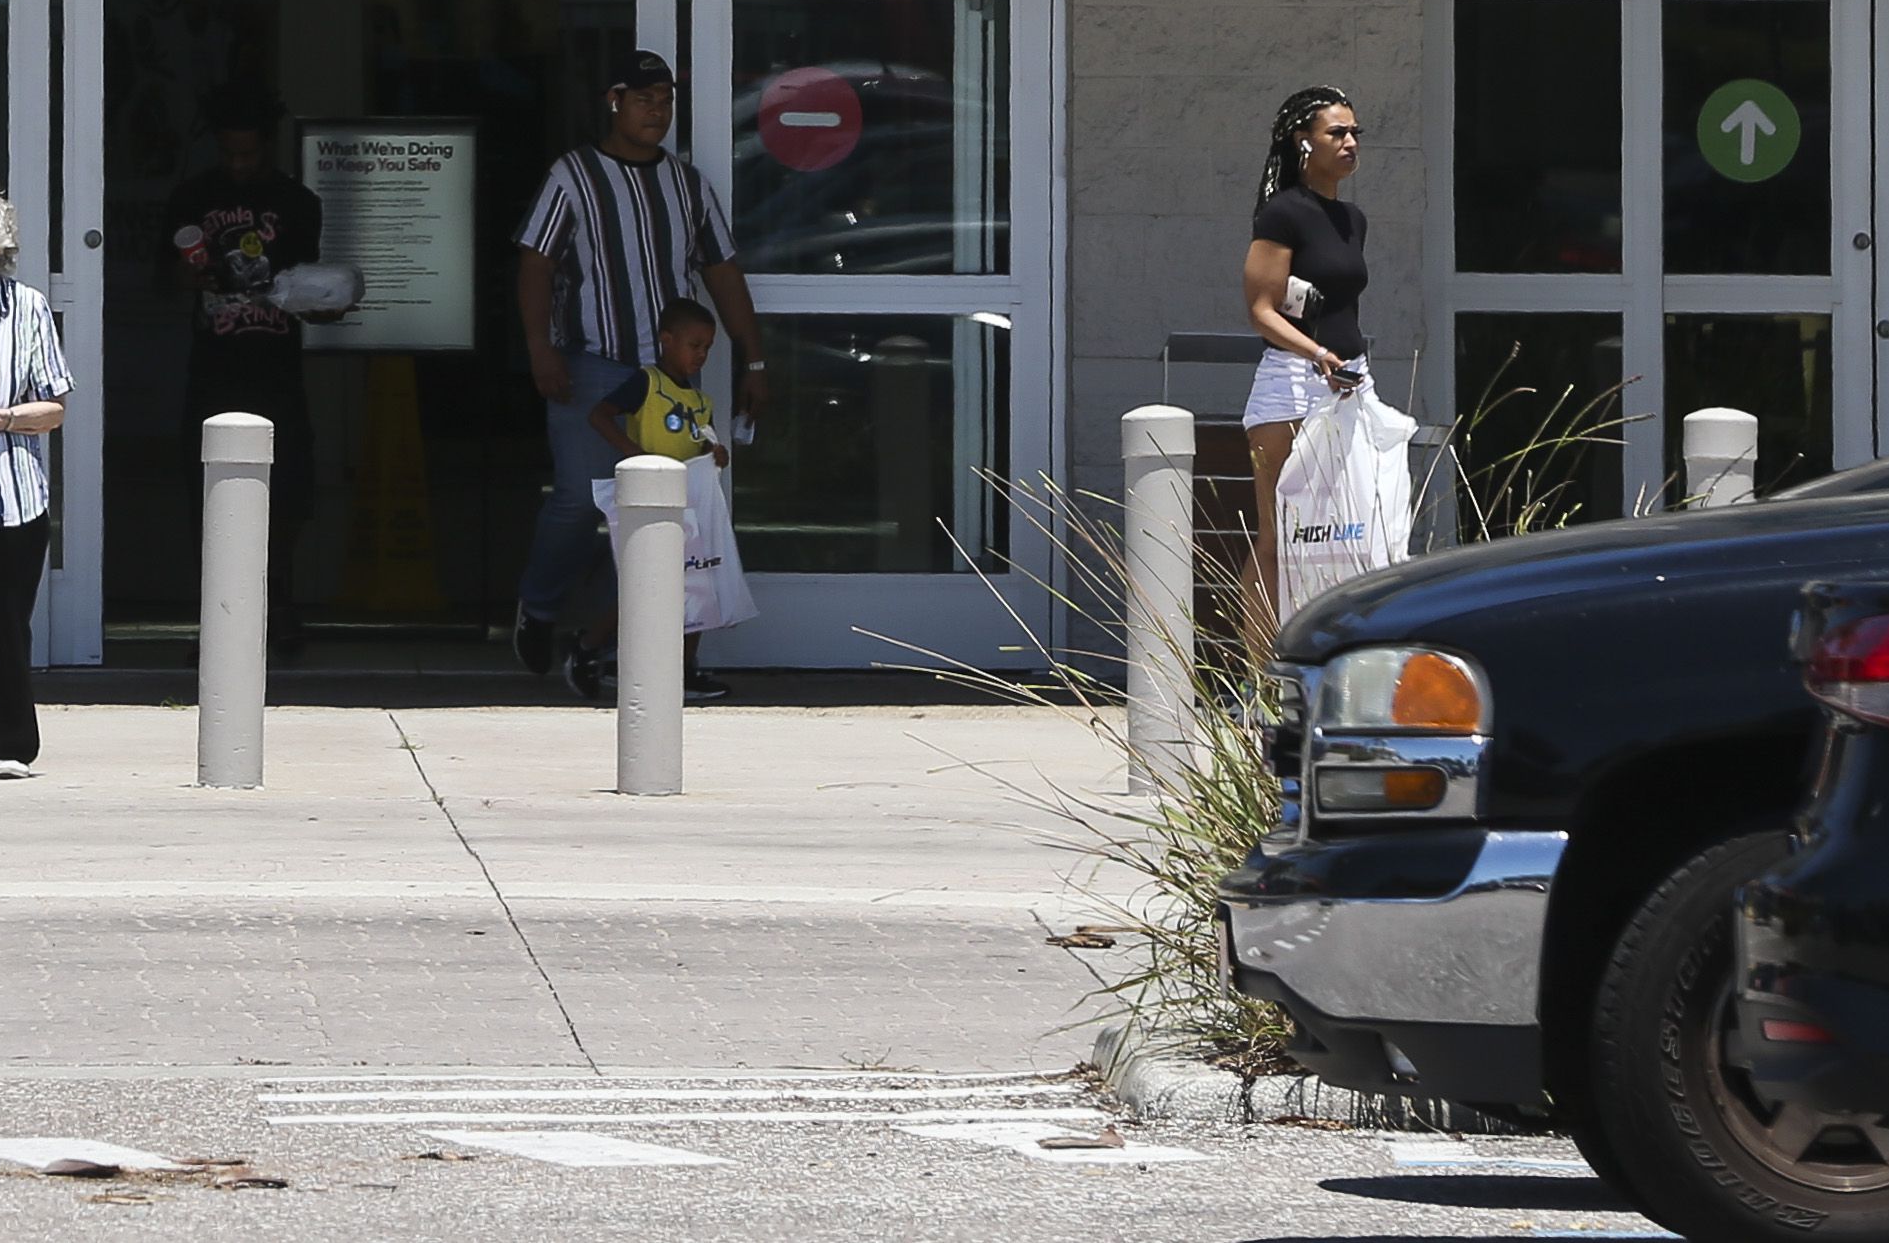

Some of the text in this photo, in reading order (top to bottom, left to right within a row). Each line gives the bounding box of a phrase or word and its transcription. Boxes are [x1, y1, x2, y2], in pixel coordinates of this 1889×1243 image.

[317, 141, 453, 159] What We're Doing
[318, 158, 441, 174] to Keep You Safe
[1660, 914, 1831, 1232] BRIDGESTON
